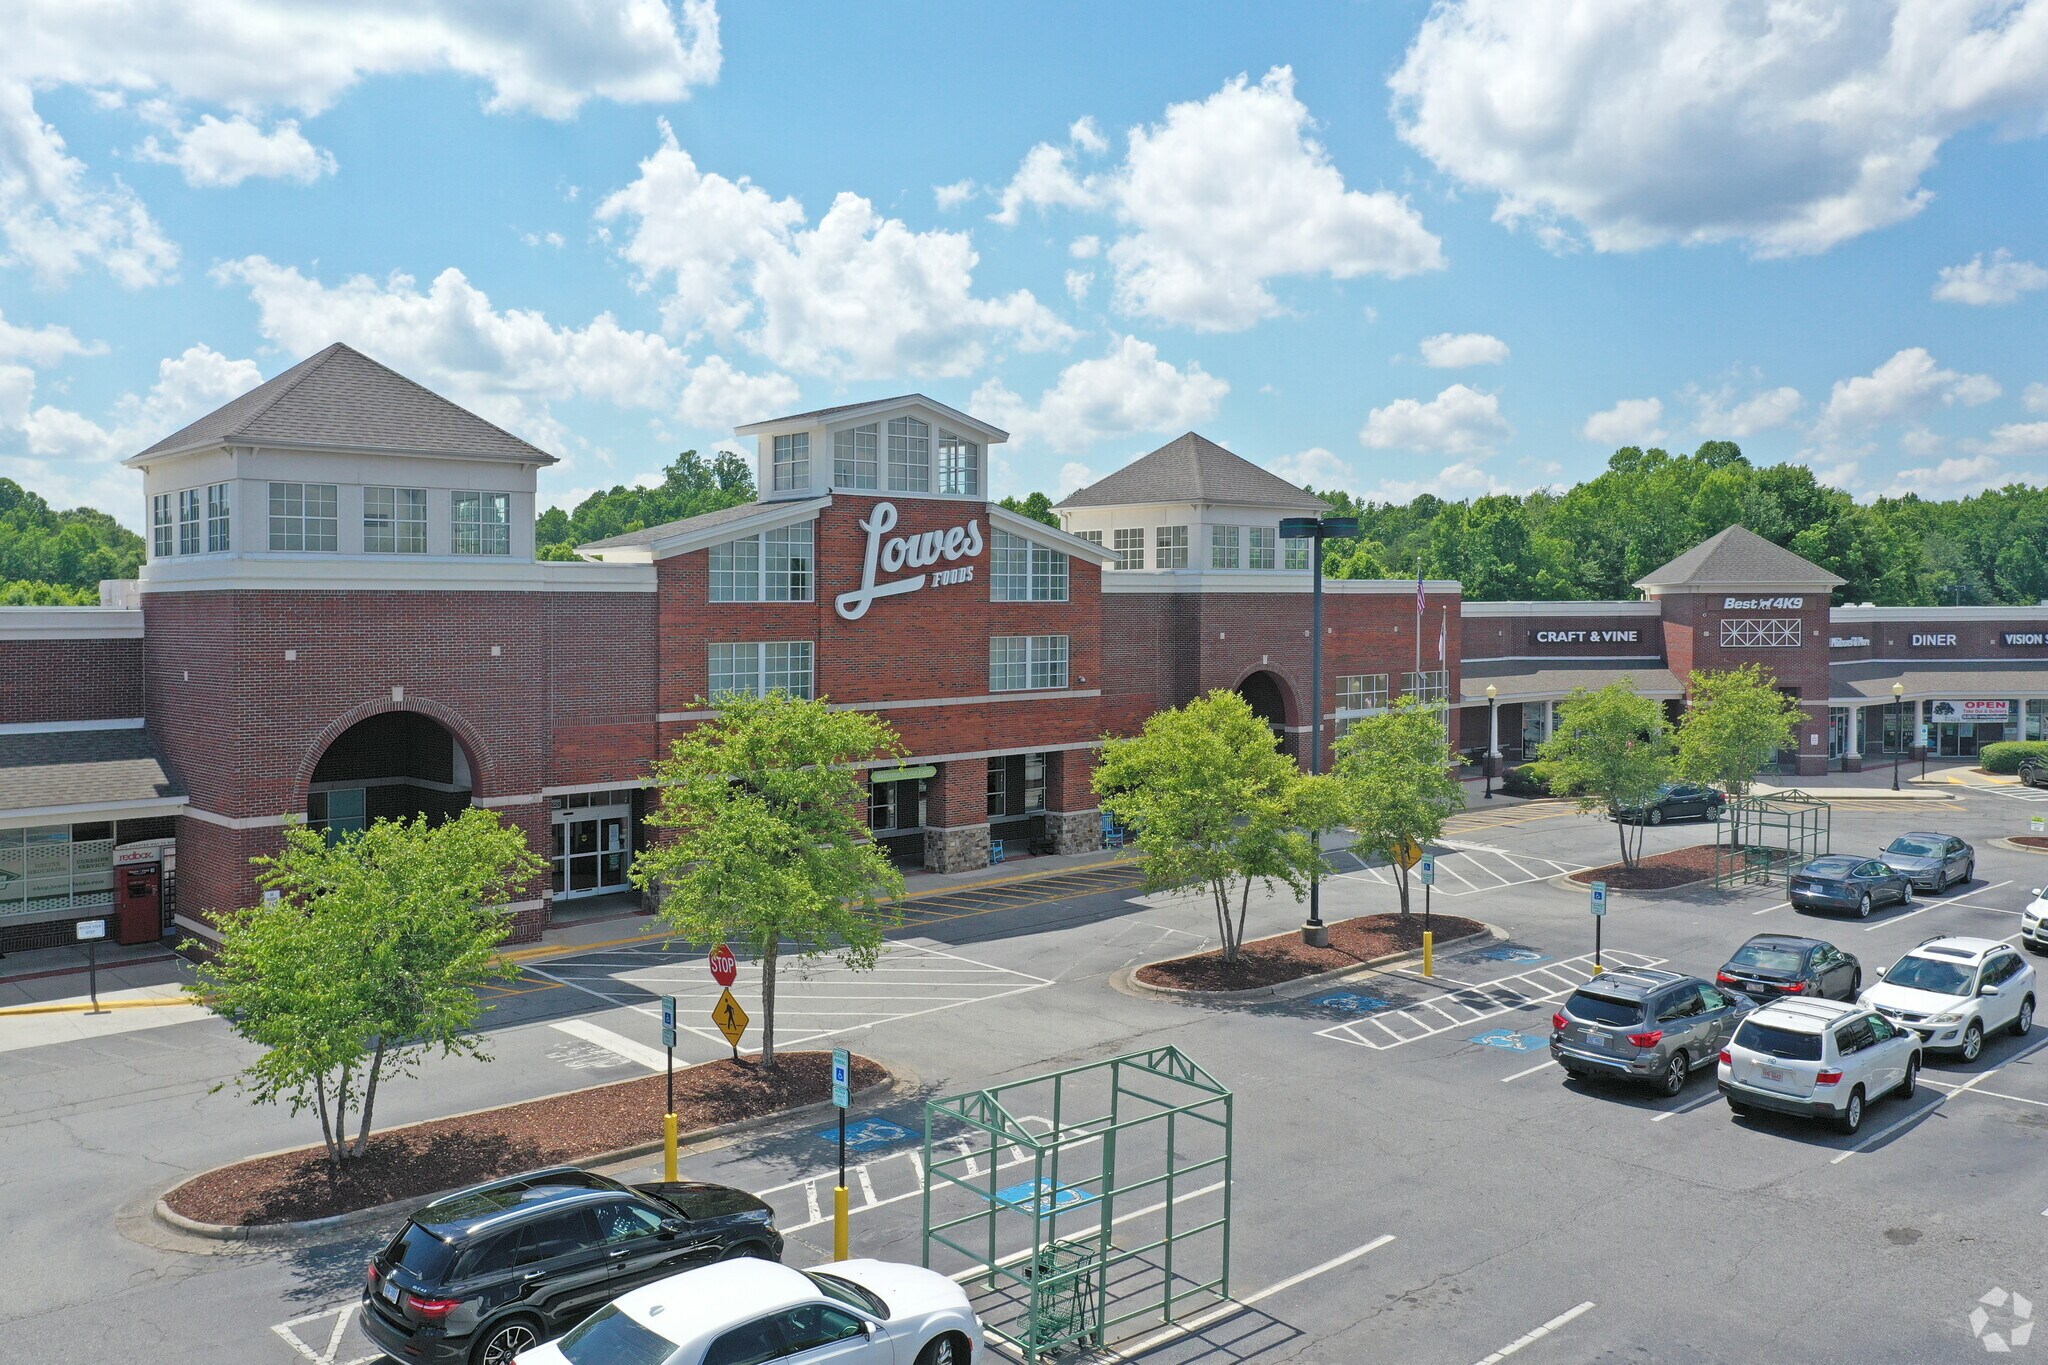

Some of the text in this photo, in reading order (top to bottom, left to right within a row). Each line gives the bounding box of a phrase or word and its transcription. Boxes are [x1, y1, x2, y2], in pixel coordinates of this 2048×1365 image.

[835, 502, 983, 620] Lowes
[931, 566, 974, 587] FOODS
[1724, 598, 1803, 609] Best 4K9
[1536, 631, 1638, 642] CRAFT & VINE
[1912, 634, 1957, 646] DINER
[2004, 634, 2043, 645] VISION
[1964, 701, 2006, 709] OPEN
[711, 956, 734, 973] STOP
